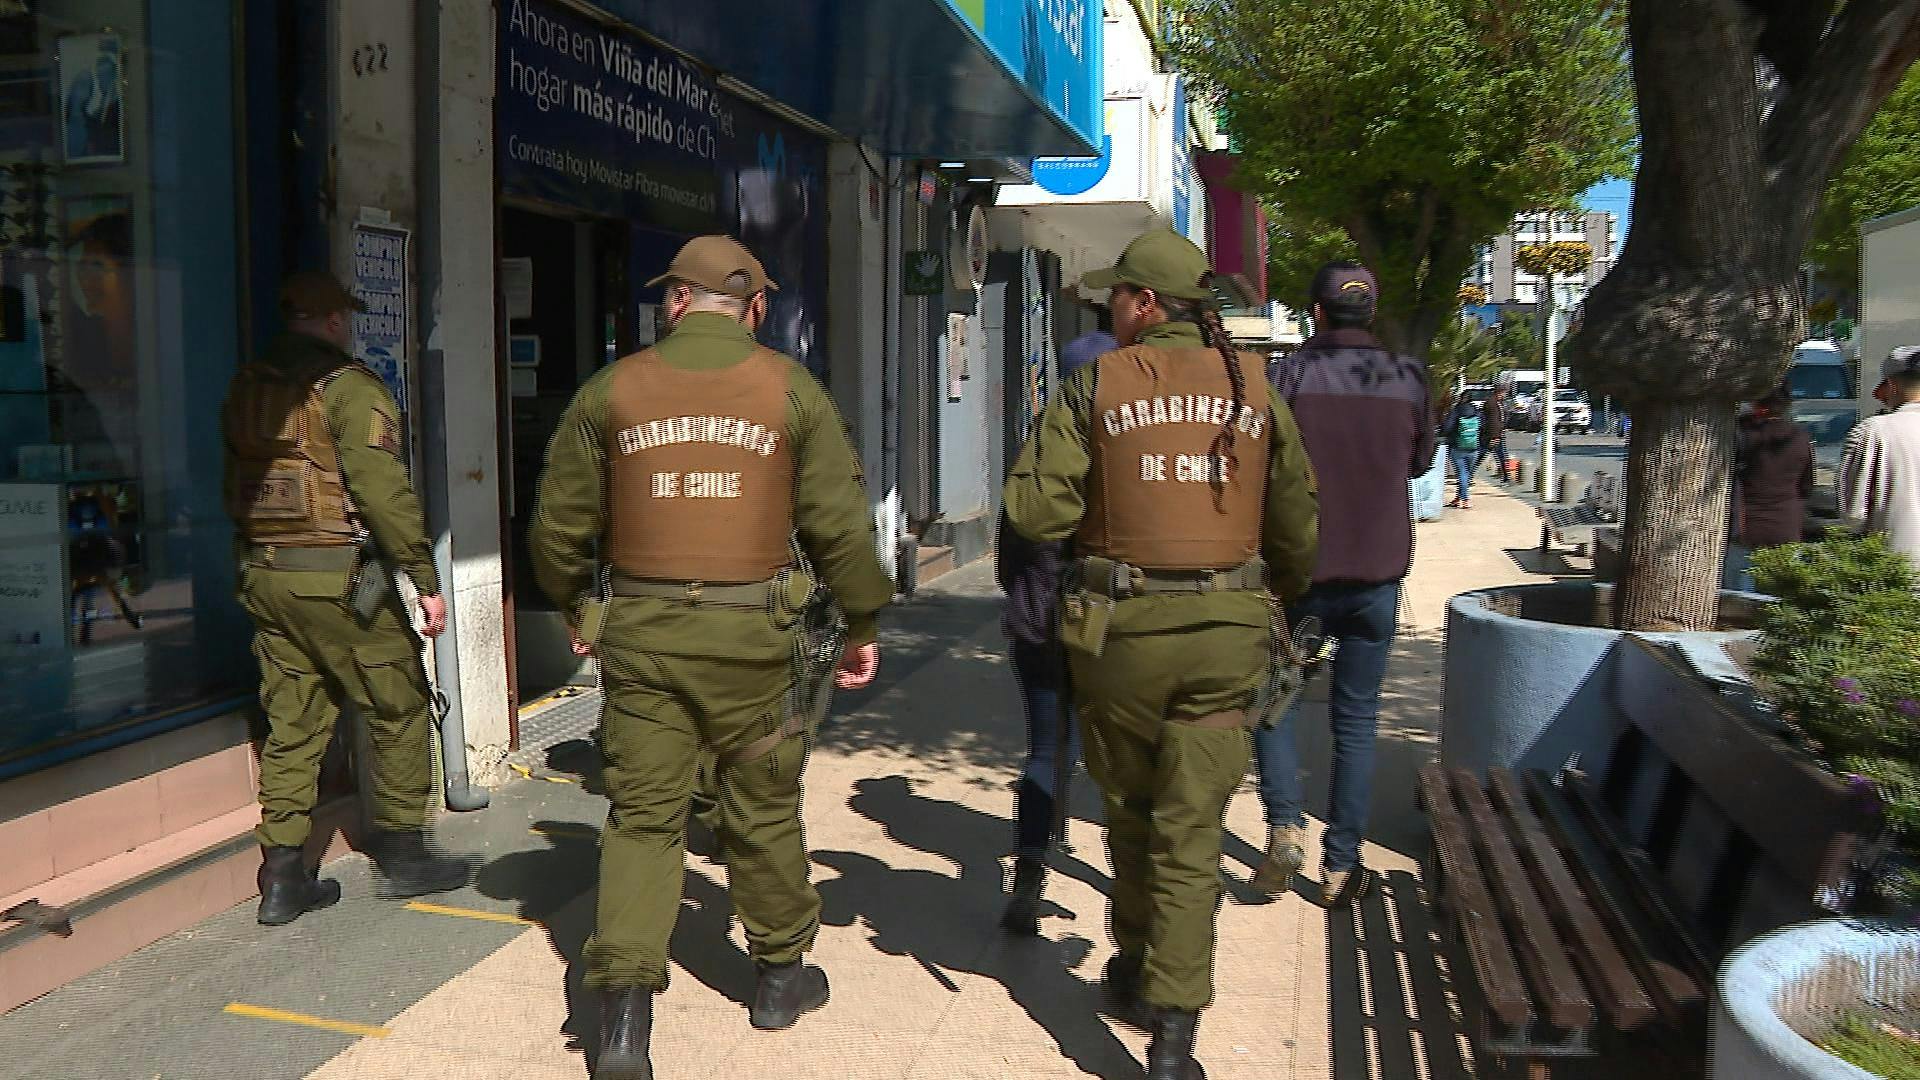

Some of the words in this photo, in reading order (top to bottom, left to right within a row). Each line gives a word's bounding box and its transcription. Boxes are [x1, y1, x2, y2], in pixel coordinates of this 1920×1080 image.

[509, 0, 568, 54] Ahora
[572, 32, 595, 66] en
[599, 33, 642, 86] Viña
[646, 56, 673, 98] del
[677, 69, 708, 110] Mar
[510, 48, 568, 112] hogar
[573, 80, 613, 123] más
[617, 92, 673, 144] rápido
[677, 116, 694, 152] de
[508, 134, 563, 172] Contrata
[566, 149, 588, 183] hoy
[590, 157, 634, 191] Movistar
[635, 171, 659, 200] Fibra
[617, 415, 781, 457] CARABINEROS
[651, 471, 681, 499] DE
[683, 471, 743, 499] CHILE
[1140, 454, 1167, 481] DE
[1174, 453, 1231, 483] CHIE
